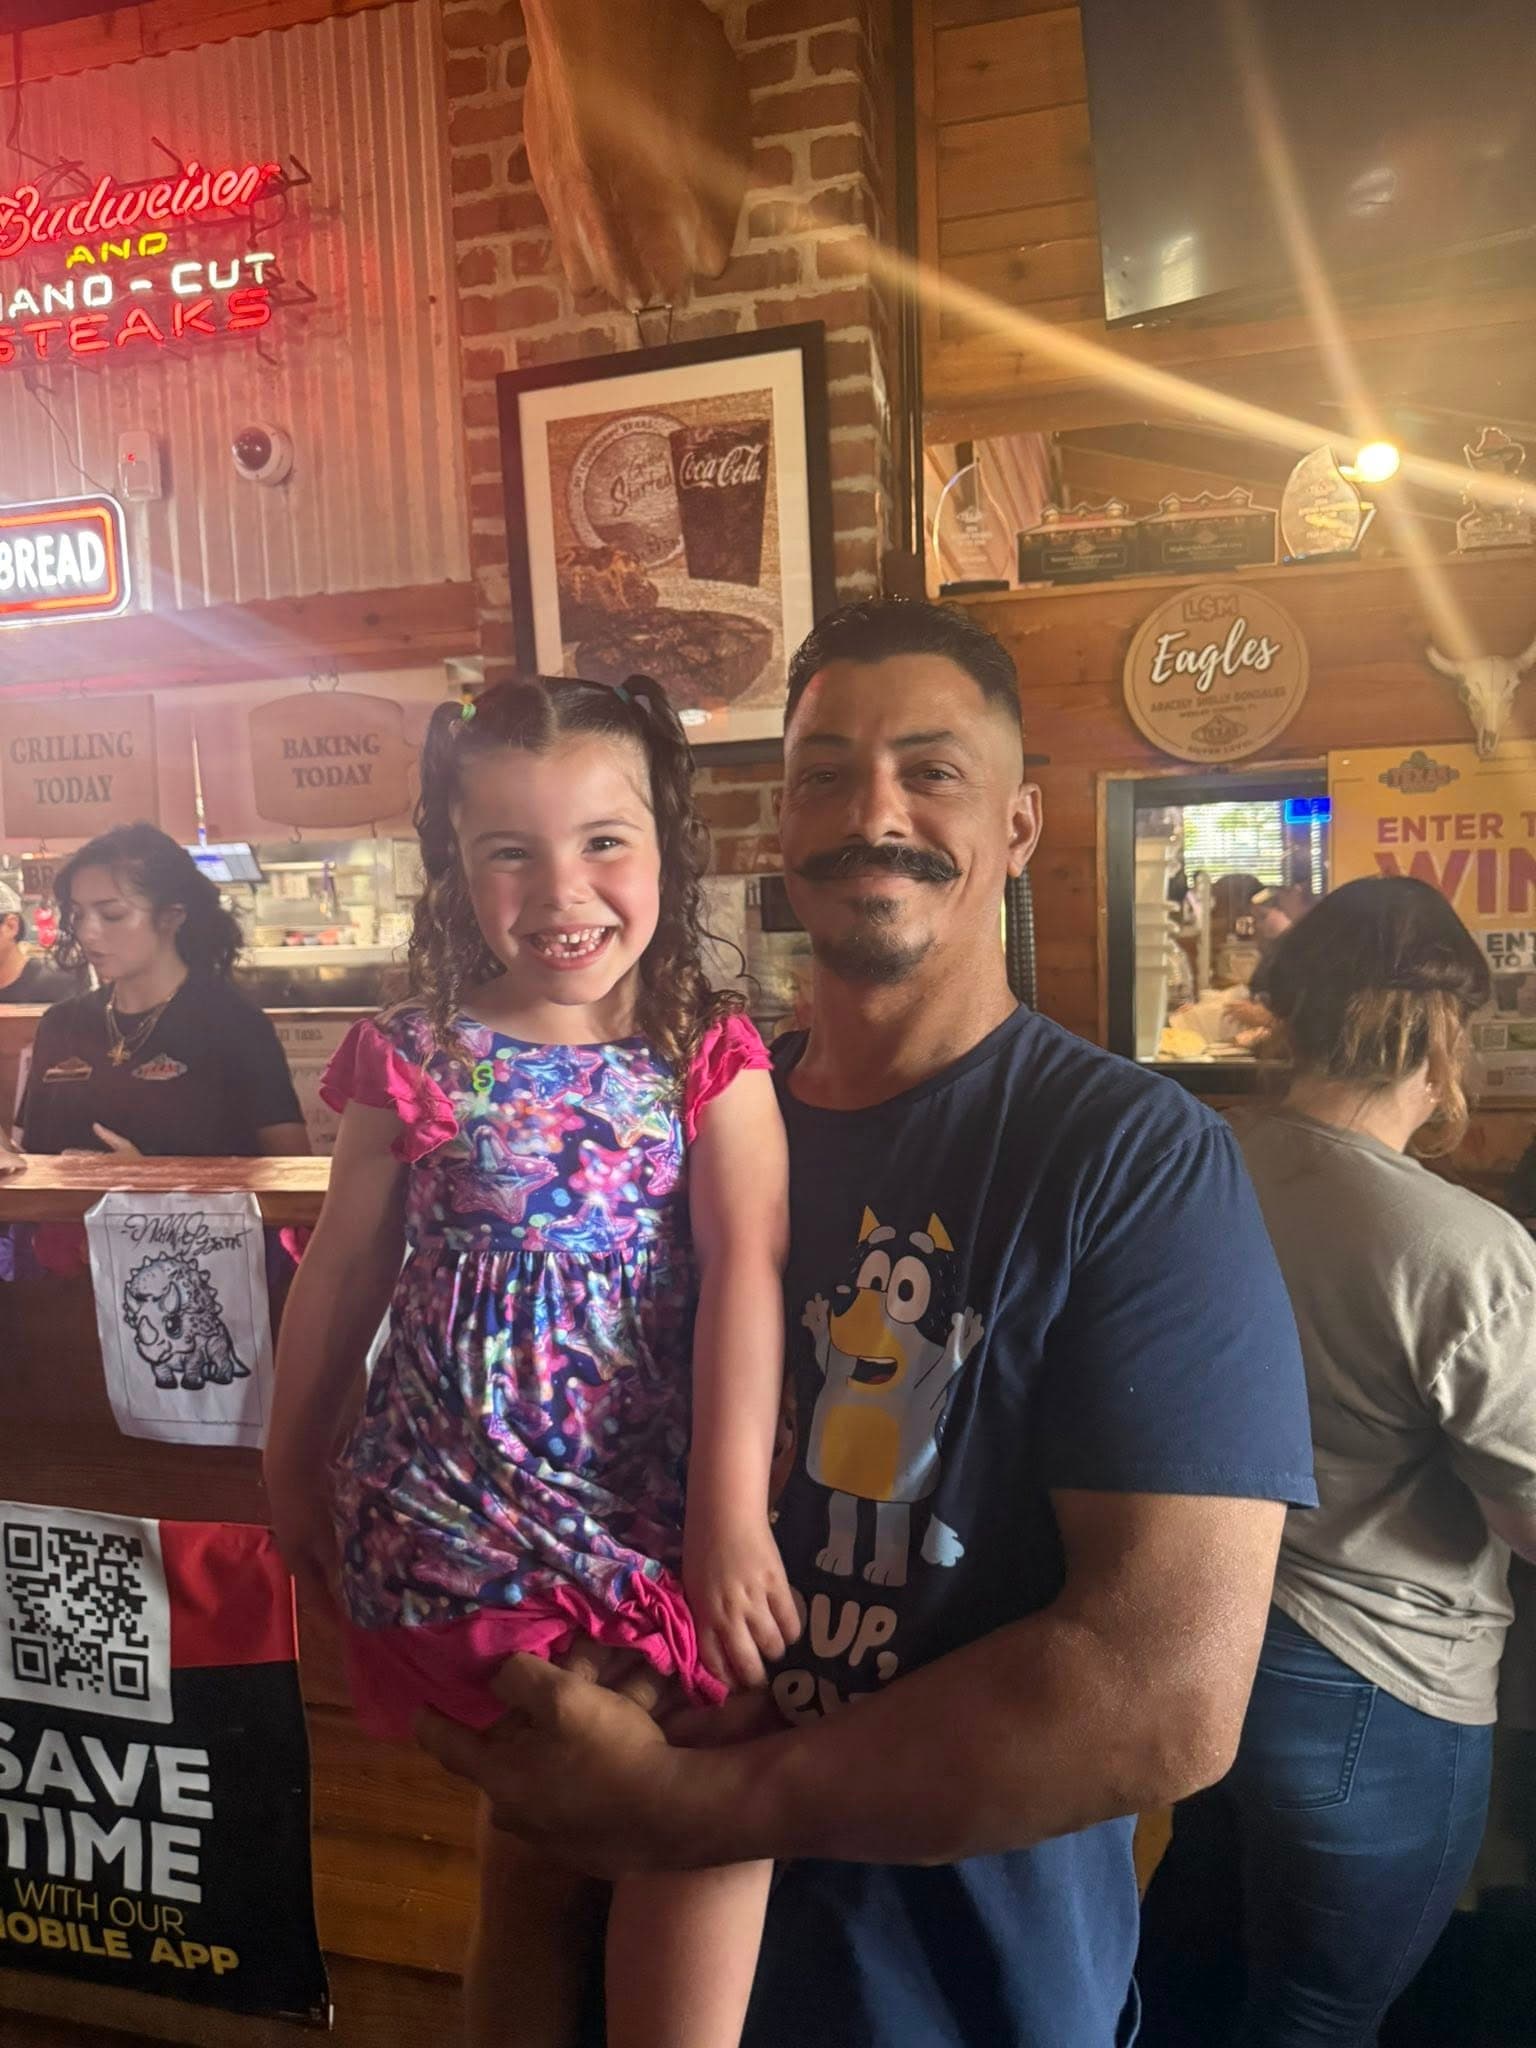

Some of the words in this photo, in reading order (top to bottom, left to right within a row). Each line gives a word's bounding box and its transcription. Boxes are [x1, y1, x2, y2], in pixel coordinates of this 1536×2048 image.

[66, 231, 169, 268] AND
[1150, 617, 1281, 692] Eagles
[10, 730, 134, 764] GRILLING
[282, 733, 381, 761] BAKING
[34, 775, 113, 804] TODAY
[291, 763, 373, 789] TODAY
[1377, 812, 1504, 843] ENTER
[1492, 953, 1522, 969] TO
[0, 1801, 202, 1903] TIME
[14, 1877, 99, 1921] WITH
[109, 1896, 186, 1936] OUR
[0, 1908, 132, 1960] OBILE
[151, 1937, 240, 1975] APP
